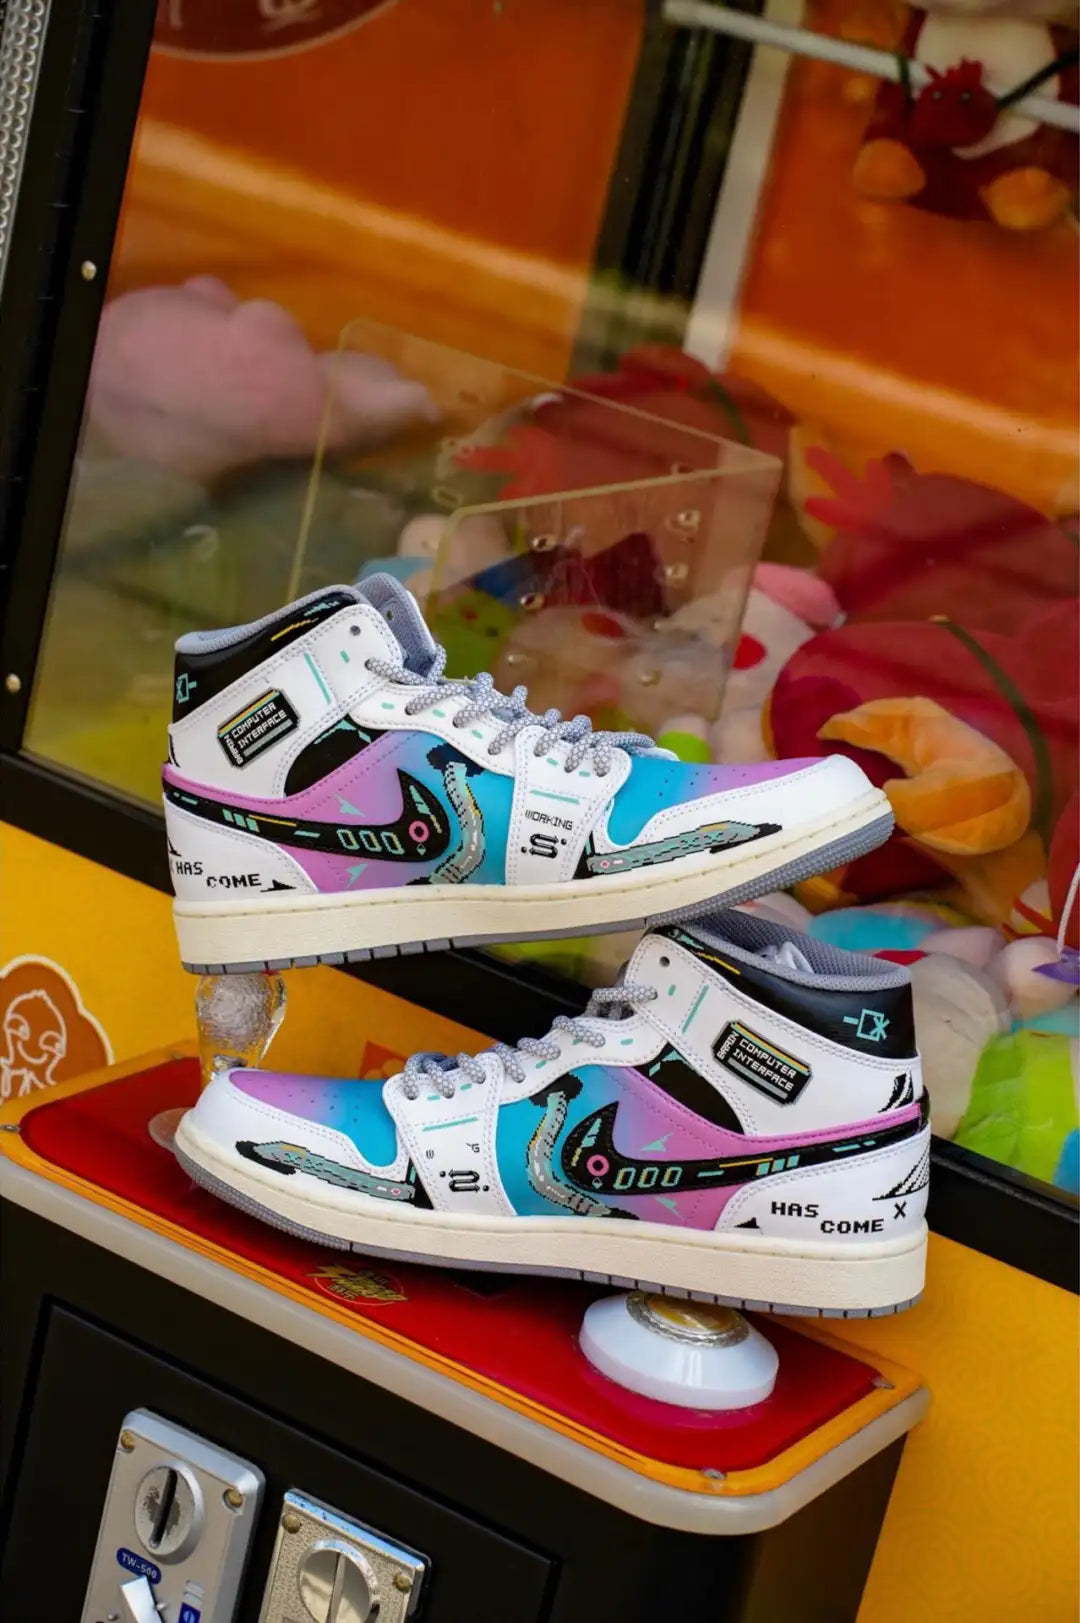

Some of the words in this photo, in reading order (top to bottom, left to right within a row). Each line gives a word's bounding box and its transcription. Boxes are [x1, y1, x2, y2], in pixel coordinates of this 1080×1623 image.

[231, 702, 277, 738] COMPUTER
[237, 709, 288, 749] INTERFACE
[525, 810, 573, 831] WORKING
[175, 861, 203, 876] HAS
[206, 873, 262, 889] COME
[716, 1031, 740, 1060] BRAIN
[733, 1048, 794, 1092] INTERFACE
[739, 1038, 797, 1079] COMPUTER
[771, 1201, 819, 1218] HAS
[820, 1219, 884, 1234] COME
